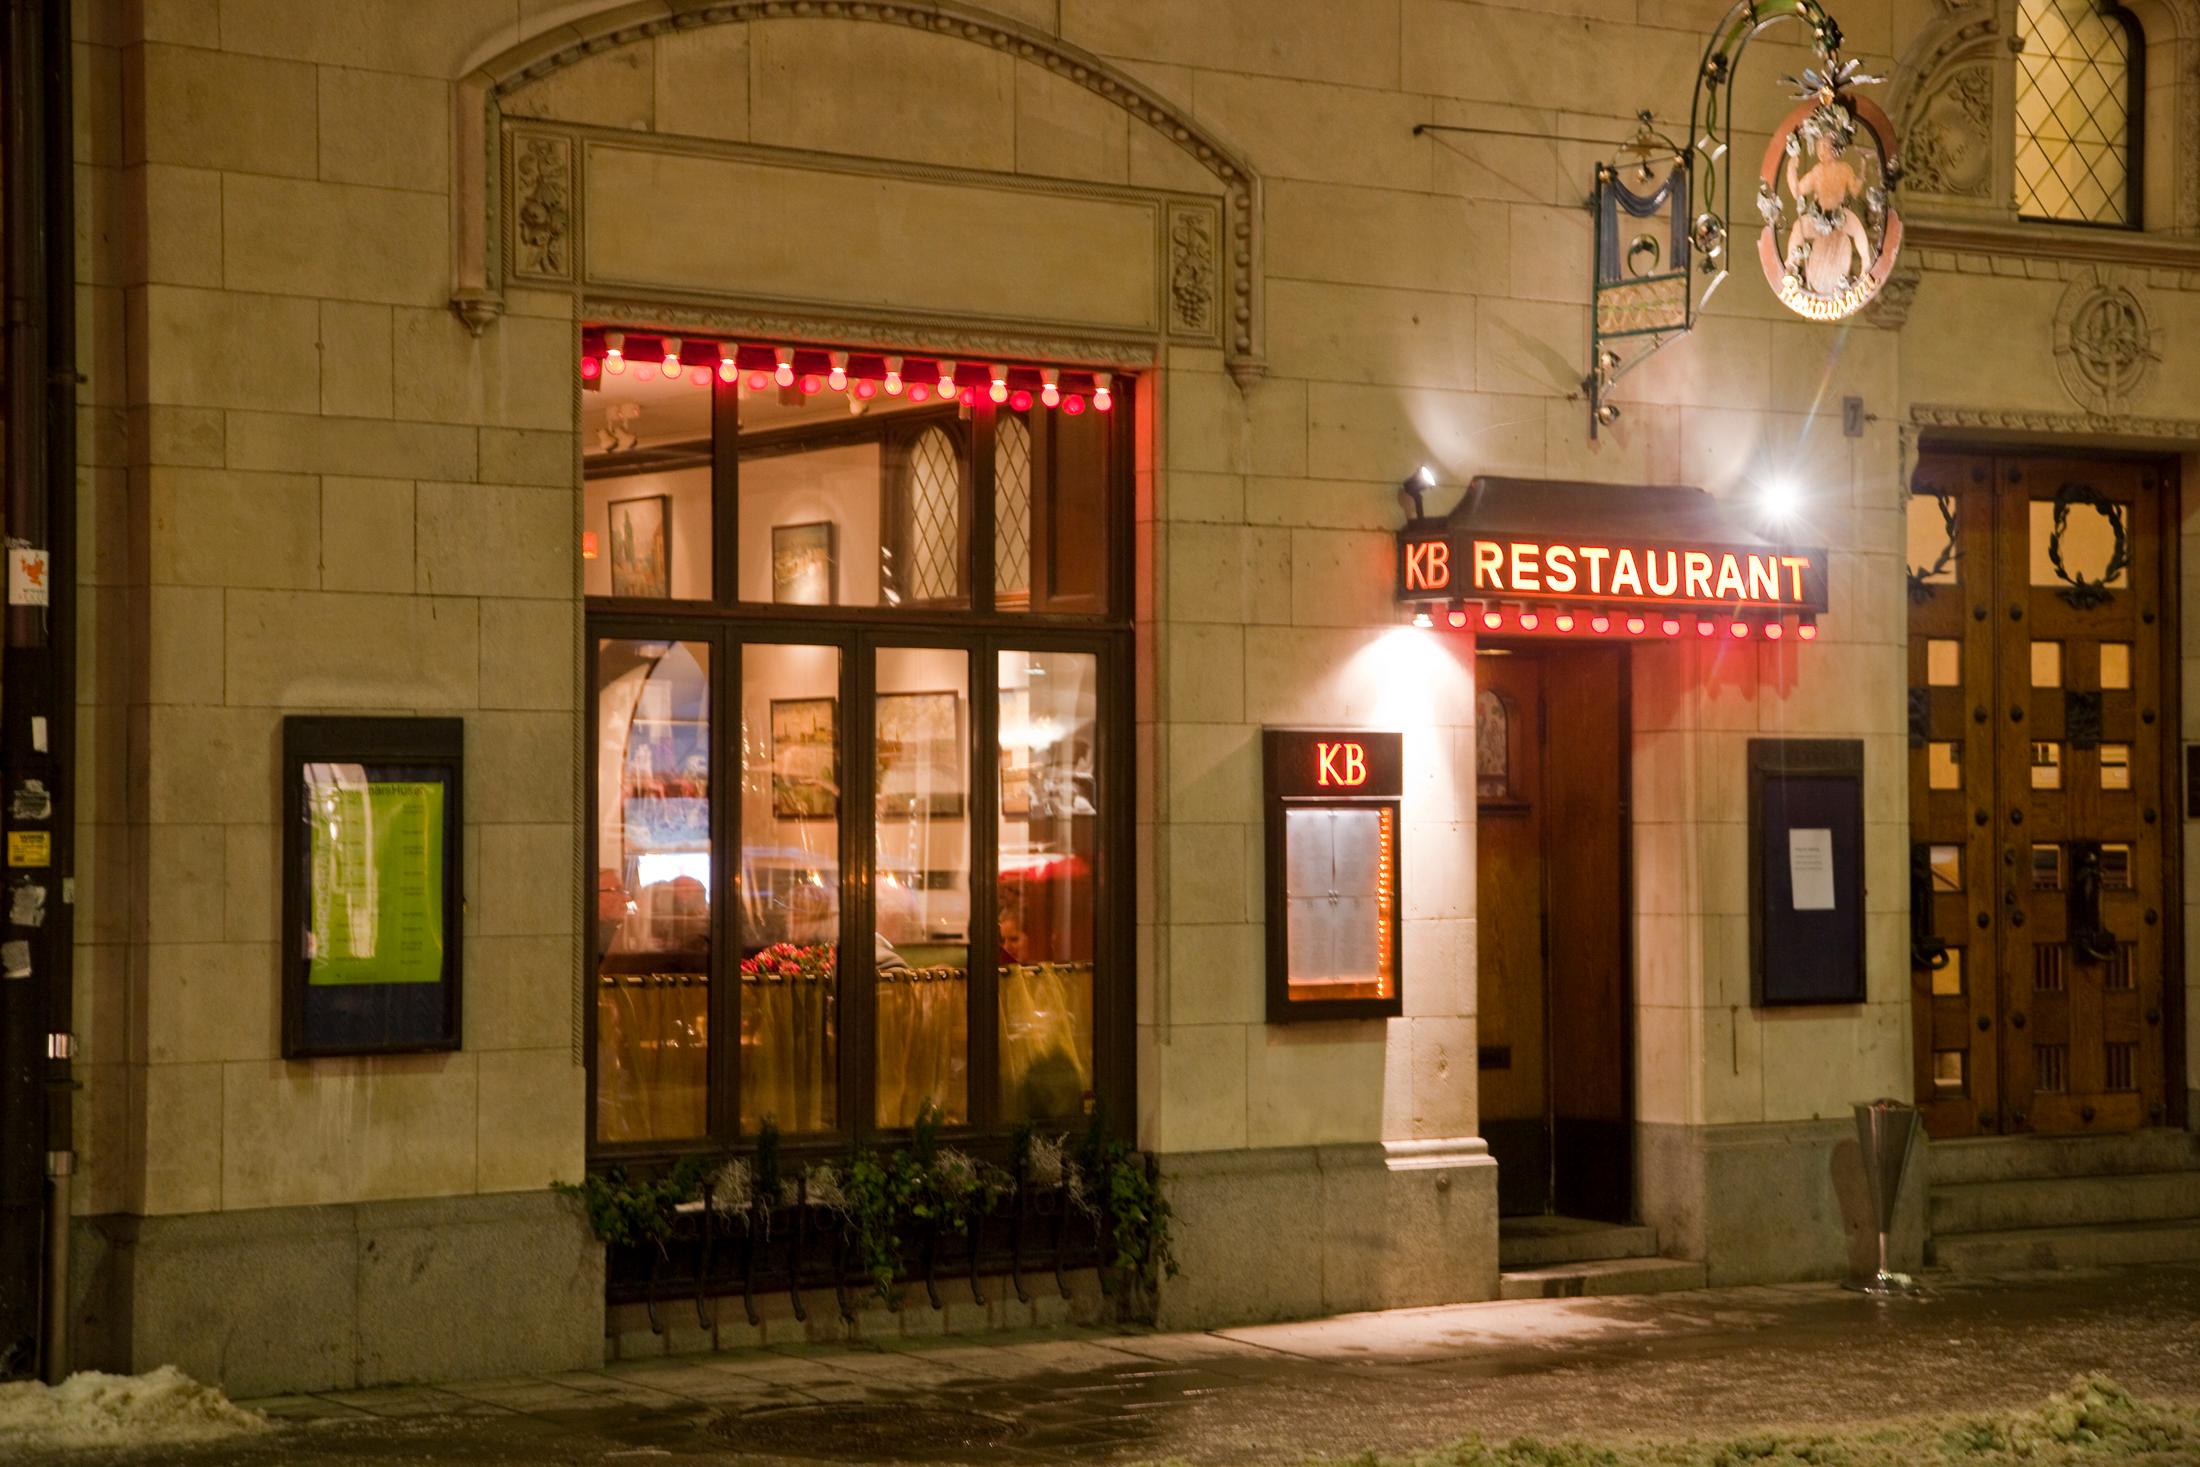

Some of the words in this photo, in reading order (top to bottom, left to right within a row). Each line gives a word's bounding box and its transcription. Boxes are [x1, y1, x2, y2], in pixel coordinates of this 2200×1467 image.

[1404, 540, 1451, 592] KB
[1472, 539, 1811, 603] RESTAURANT
[1317, 742, 1368, 787] KB
